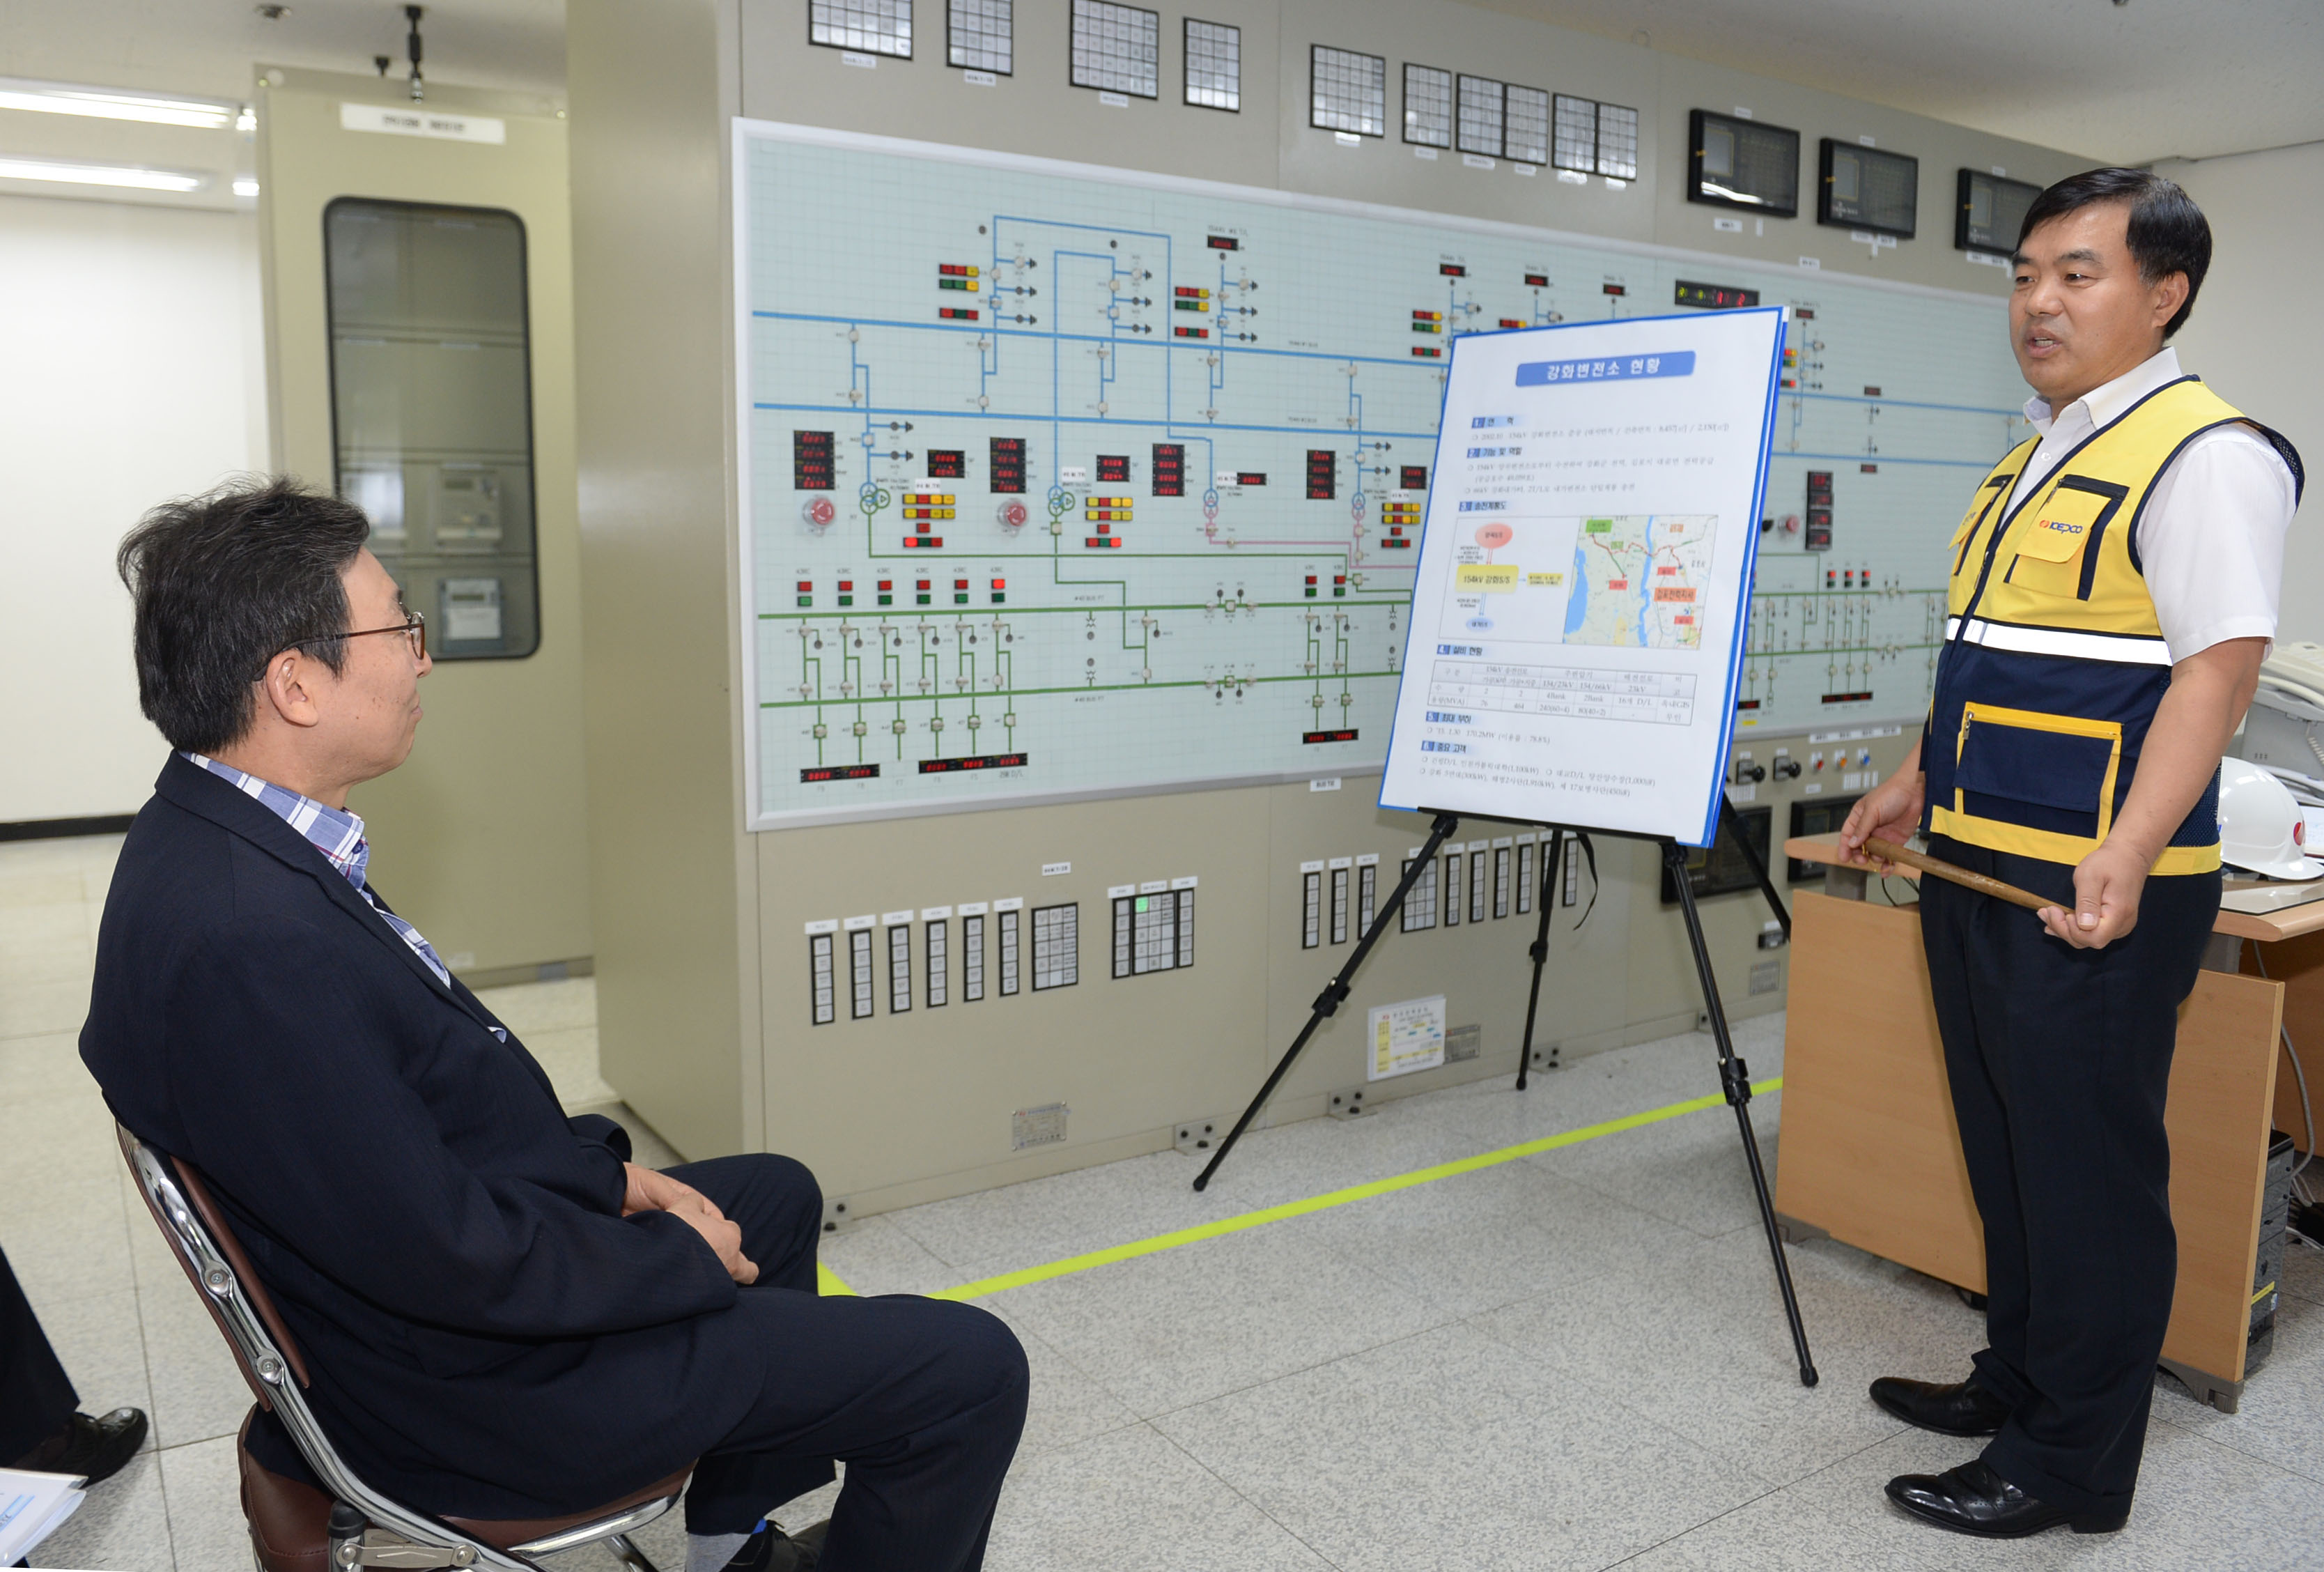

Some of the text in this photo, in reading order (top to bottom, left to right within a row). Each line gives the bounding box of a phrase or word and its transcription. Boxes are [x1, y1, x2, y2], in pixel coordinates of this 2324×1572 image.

[1547, 357, 1661, 380] 강화변전소 현황
[2050, 521, 2083, 534] KEPCO
[1464, 575, 1484, 584] 154kV
